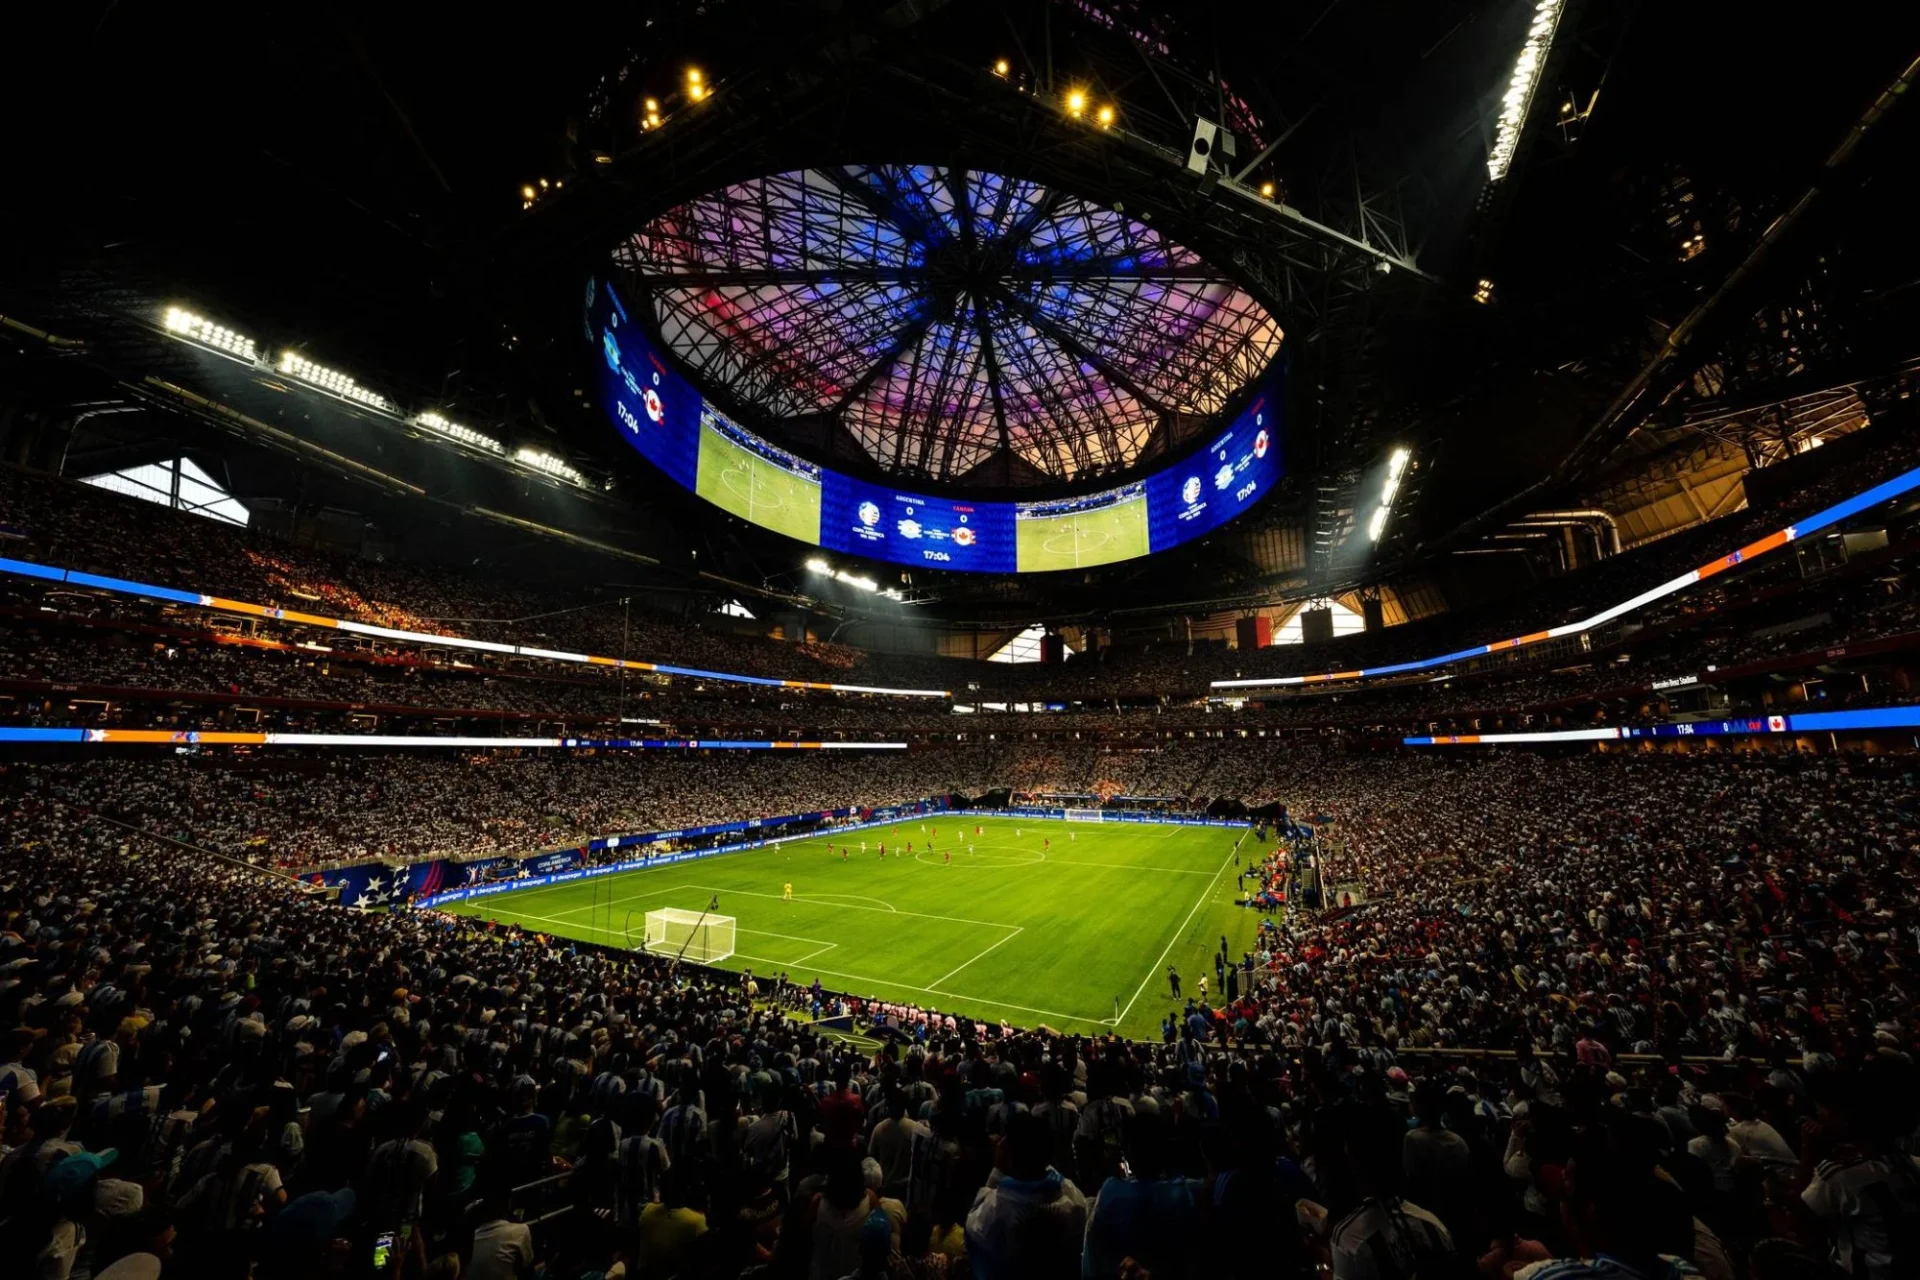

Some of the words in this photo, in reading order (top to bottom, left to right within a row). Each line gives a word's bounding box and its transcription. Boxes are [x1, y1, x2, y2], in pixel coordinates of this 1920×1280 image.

[653, 371, 660, 386] 0
[617, 400, 639, 435] 17:04
[1257, 413, 1263, 426] 0
[1220, 449, 1226, 461] 0
[1236, 480, 1257, 503] 17:04
[895, 495, 925, 506] ARGENTINA
[906, 506, 914, 516] 0
[960, 514, 968, 523] 0
[923, 550, 951, 562] 17:04
[1677, 723, 1694, 735] 17:04
[477, 885, 508, 896] despegar
